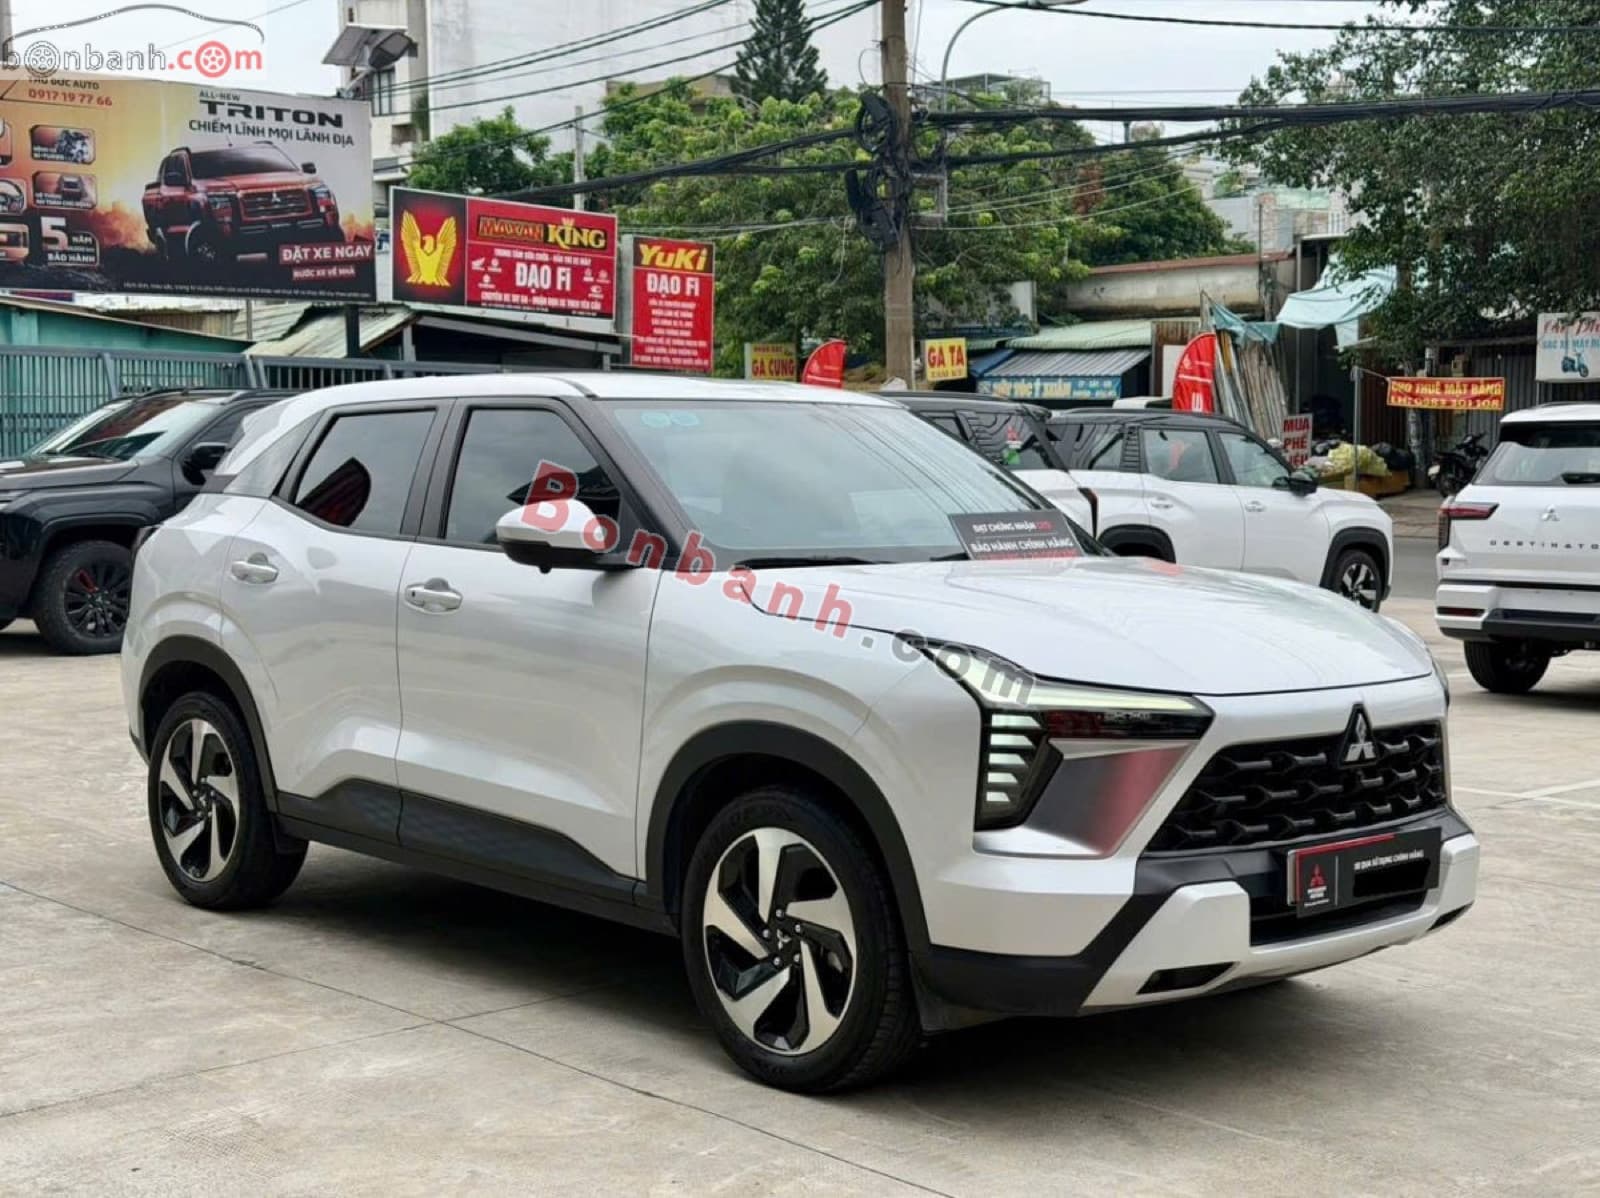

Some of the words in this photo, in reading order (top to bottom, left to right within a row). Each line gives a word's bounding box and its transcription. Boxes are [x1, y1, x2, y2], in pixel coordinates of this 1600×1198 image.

[28, 88, 59, 101] 0917
[61, 91, 76, 103] 19
[78, 94, 94, 105] 77
[96, 96, 113, 107] 66
[72, 79, 99, 90] AUTO
[199, 90, 241, 102] ALL-NEW
[199, 99, 343, 128] TRITON
[188, 117, 232, 135] CHIẾM
[269, 127, 293, 143] MỌI
[295, 127, 329, 144] LÃNH
[331, 132, 355, 149] ĐỊA
[41, 216, 69, 251] 5
[547, 221, 606, 250] KING
[282, 245, 311, 264] ĐẶT
[313, 247, 332, 261] XE
[334, 244, 373, 259] NGAY
[515, 261, 552, 294] ĐẠO
[647, 272, 681, 299] ĐẠO
[1283, 417, 1310, 433] MUA
